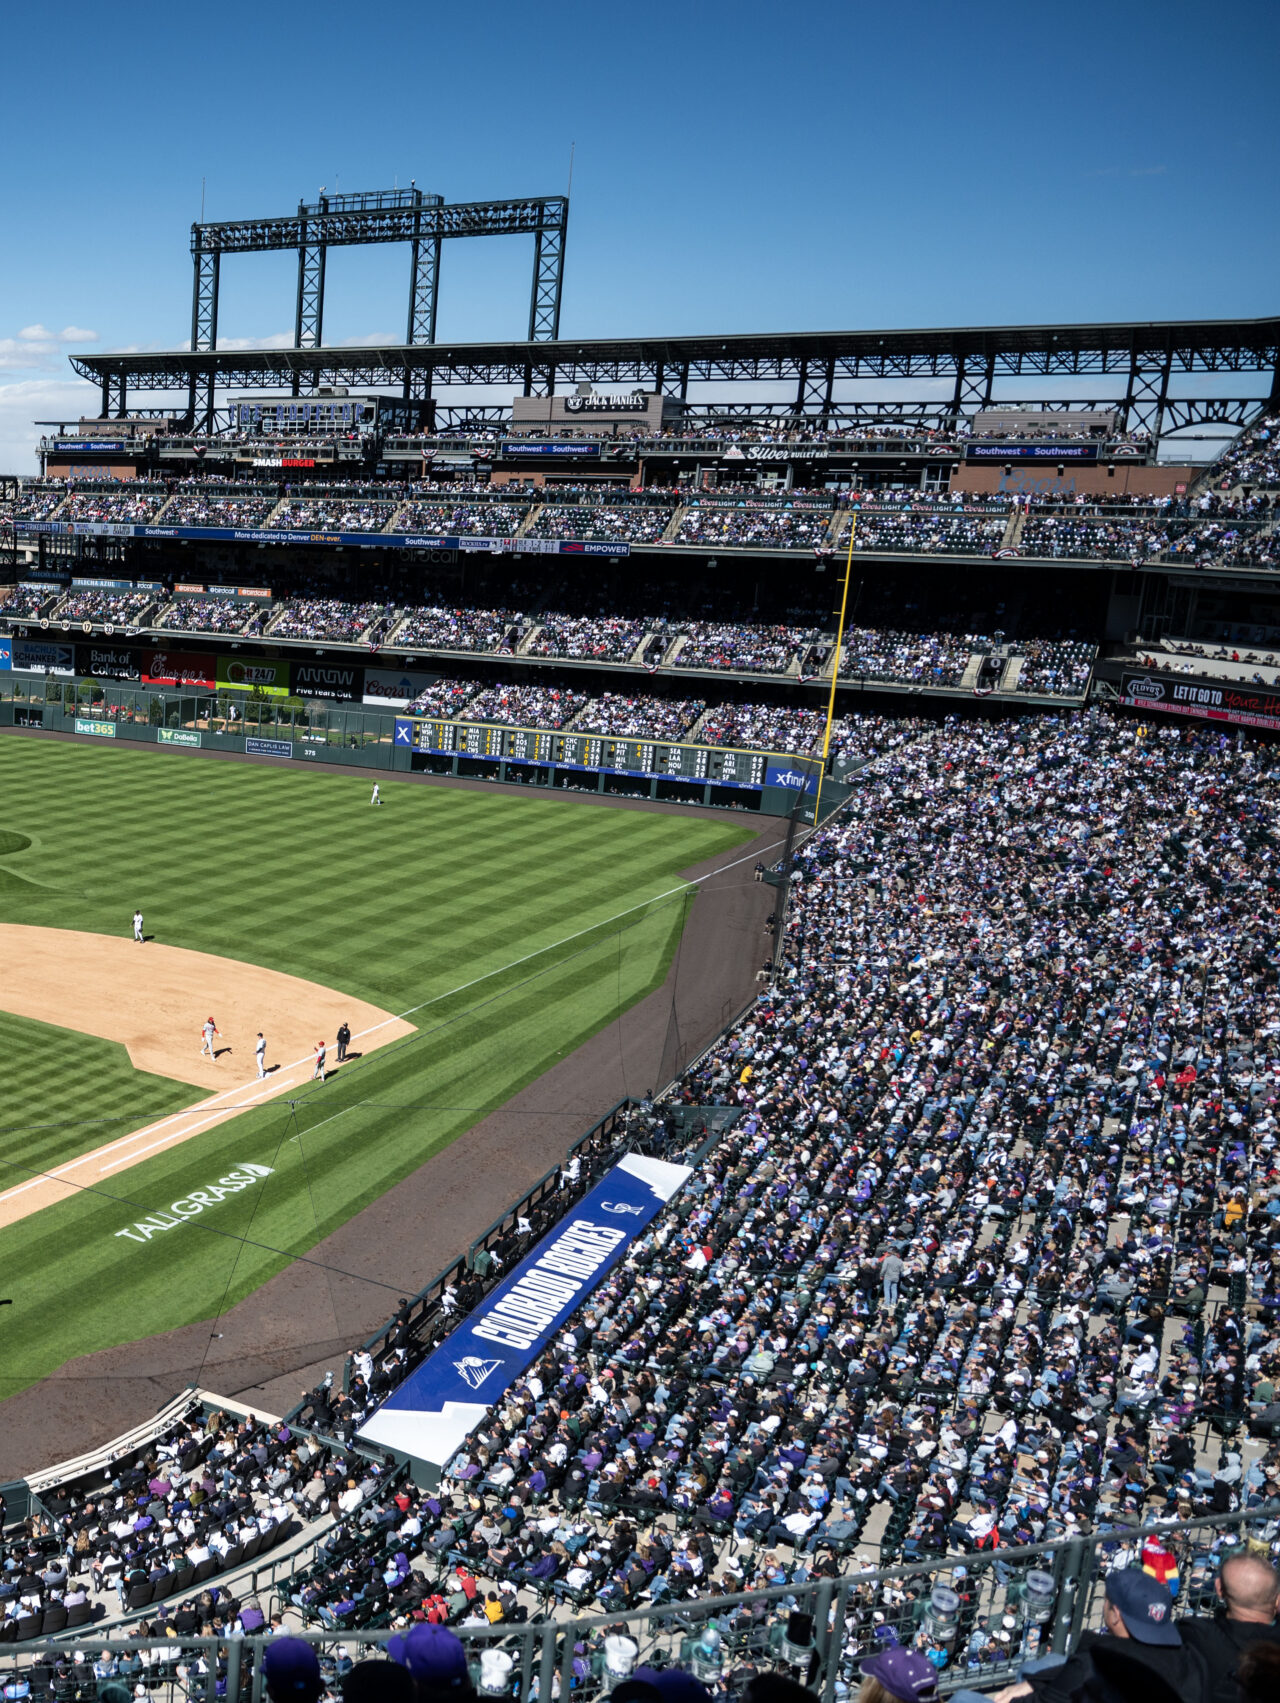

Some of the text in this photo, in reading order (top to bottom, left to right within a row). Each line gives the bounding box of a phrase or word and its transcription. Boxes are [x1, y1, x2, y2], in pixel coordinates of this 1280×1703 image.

[585, 392, 608, 405] JACK
[228, 403, 365, 421] THE ROOFTOP
[508, 445, 543, 453] Southwest
[747, 446, 789, 460] Silver
[975, 447, 1020, 455] Southwest
[1034, 447, 1081, 456] Southwest
[253, 458, 315, 467] SMASHBURGER
[882, 503, 901, 511] LIGHT
[932, 504, 952, 512] LIGHT
[145, 527, 174, 536] Southwest
[234, 531, 250, 539] More
[251, 532, 280, 540] dedicated
[288, 533, 310, 541] Denver
[310, 534, 341, 542] DEN-ever.
[405, 538, 441, 546] Southwest
[584, 545, 627, 553] EMPOWER
[14, 652, 57, 663] SCHANKER
[91, 650, 131, 663] Bank of
[91, 663, 140, 678] Colorado
[255, 668, 275, 680] 24/7
[297, 667, 354, 685] ARROW
[296, 687, 352, 698] Five Years Out
[365, 680, 405, 698] Coors
[1174, 685, 1222, 704] LET IT GO TO
[76, 721, 114, 736] bet365
[174, 733, 197, 742] DaBella
[616, 742, 627, 750] BAL
[304, 749, 316, 757] 375
[722, 767, 736, 775] NYM
[776, 771, 811, 791] xfinity
[114, 1172, 257, 1242] TALLGRASS
[472, 1219, 627, 1350] COLORADO ROCKIES
